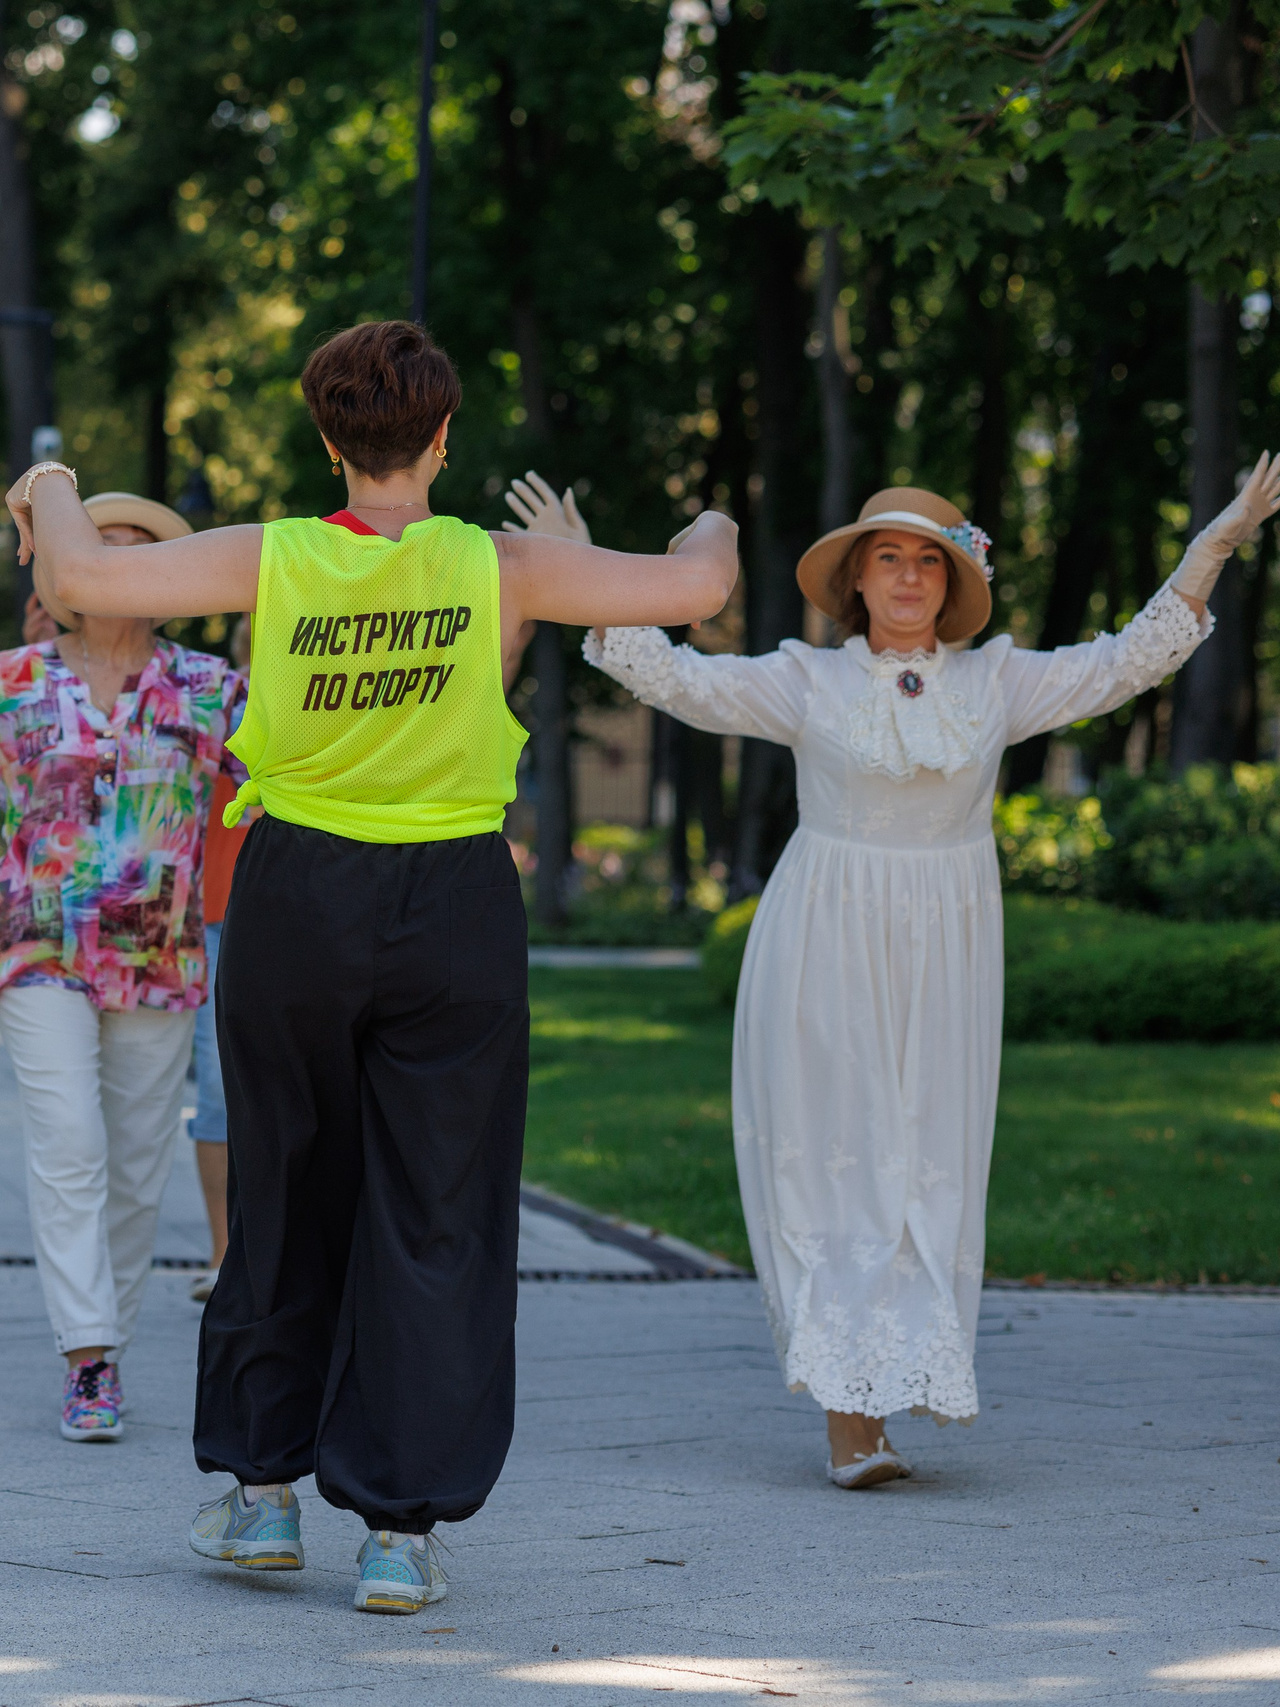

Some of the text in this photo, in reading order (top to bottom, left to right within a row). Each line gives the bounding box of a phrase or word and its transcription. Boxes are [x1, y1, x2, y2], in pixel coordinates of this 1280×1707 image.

[288, 606, 472, 656] ИНСТРУКТОР
[301, 664, 456, 711] ПО СПОРТУ
